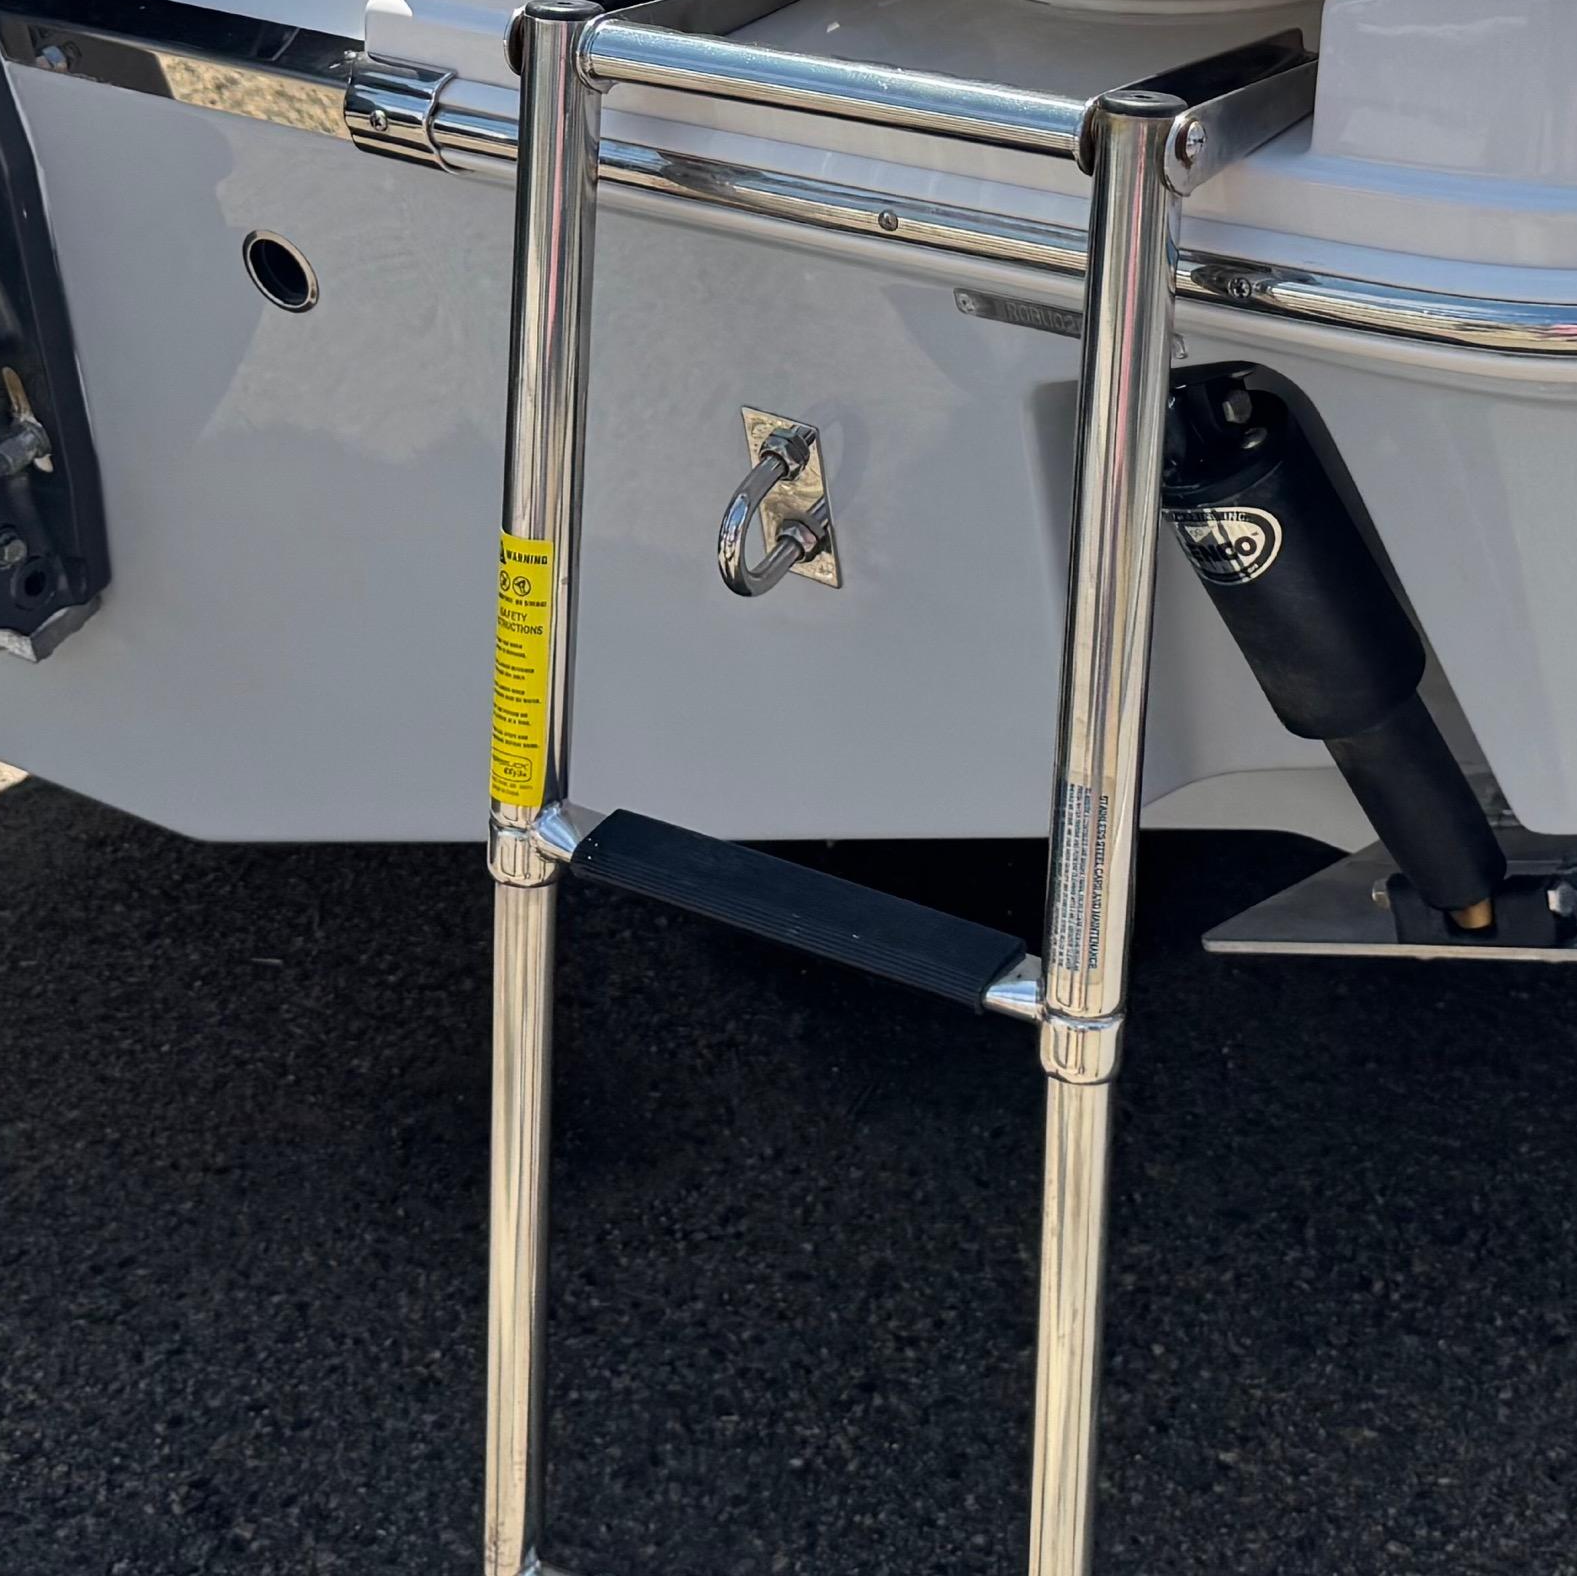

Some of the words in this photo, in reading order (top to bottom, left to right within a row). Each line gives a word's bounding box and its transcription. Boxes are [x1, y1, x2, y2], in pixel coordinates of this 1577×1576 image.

[506, 549, 548, 565] WARNING
[1094, 841, 1106, 867] STEEL
[1088, 910, 1100, 970] MAINTENANCE
